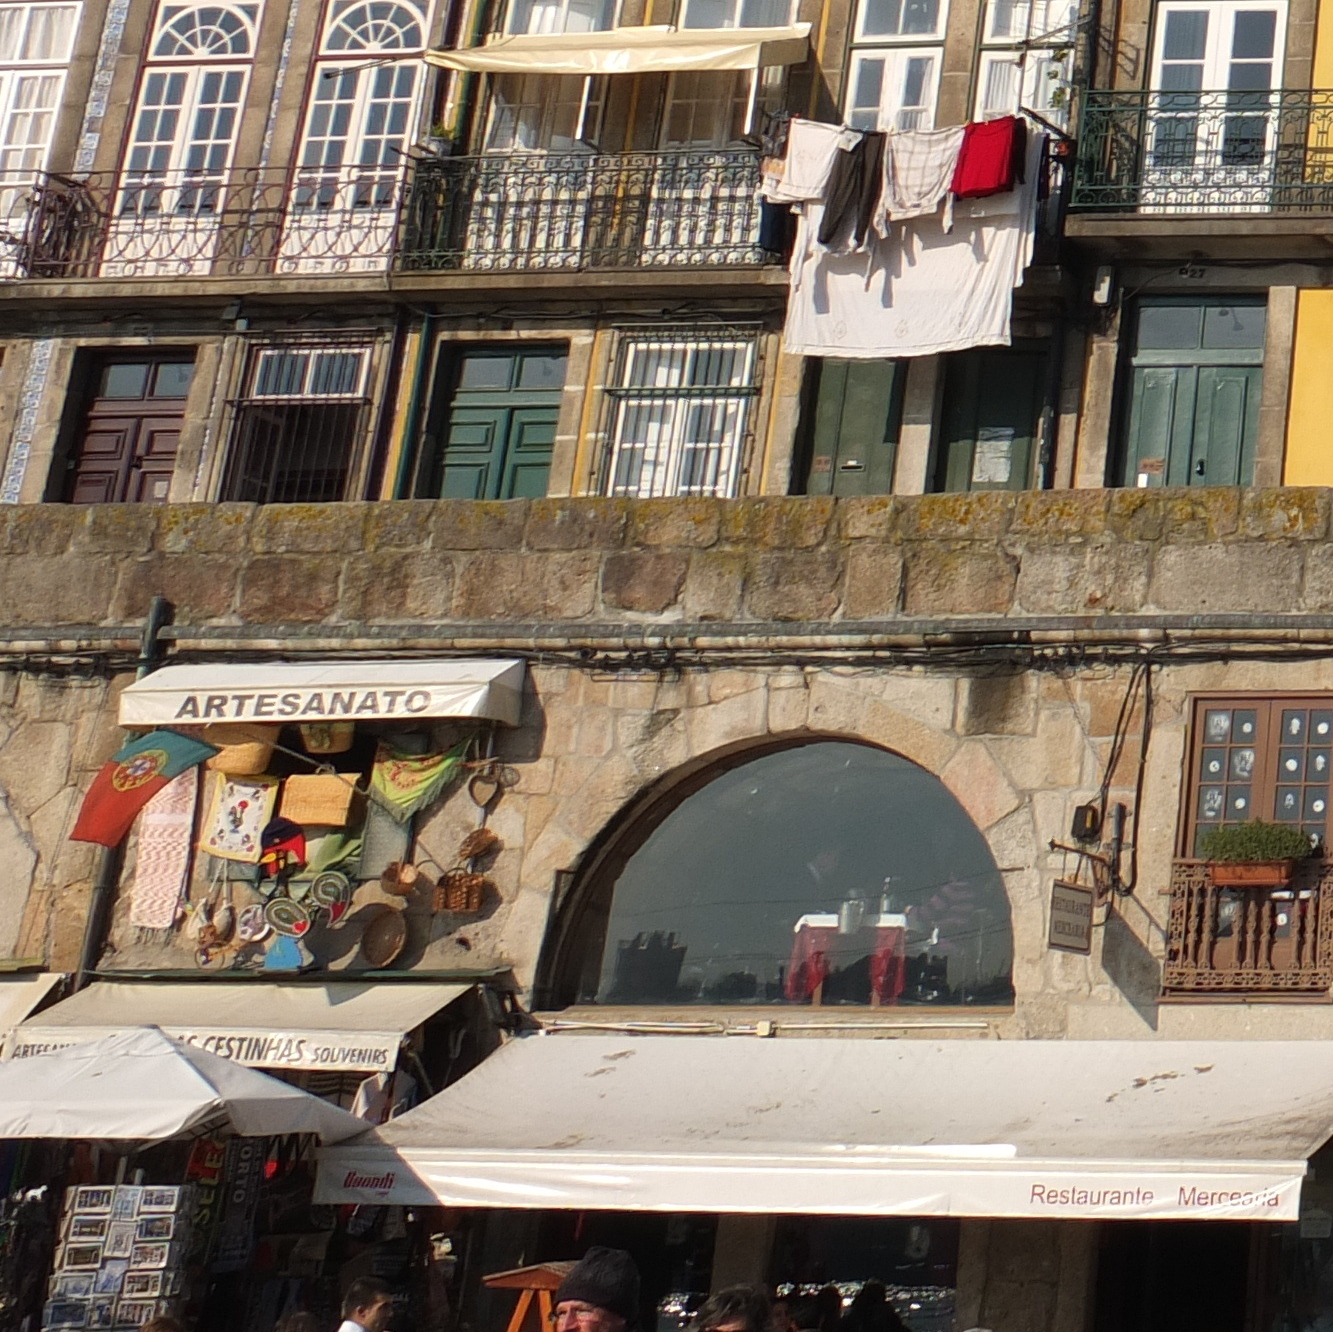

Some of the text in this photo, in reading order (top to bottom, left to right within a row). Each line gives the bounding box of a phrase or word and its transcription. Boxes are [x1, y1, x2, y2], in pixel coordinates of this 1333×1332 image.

[174, 690, 431, 718] ARTESANATO
[202, 1036, 306, 1062] CESTINHAS
[311, 1047, 389, 1064] SOUVENIRS
[233, 1139, 254, 1203] ORTO
[1030, 1184, 1279, 1207] Restaurante Mercearia
